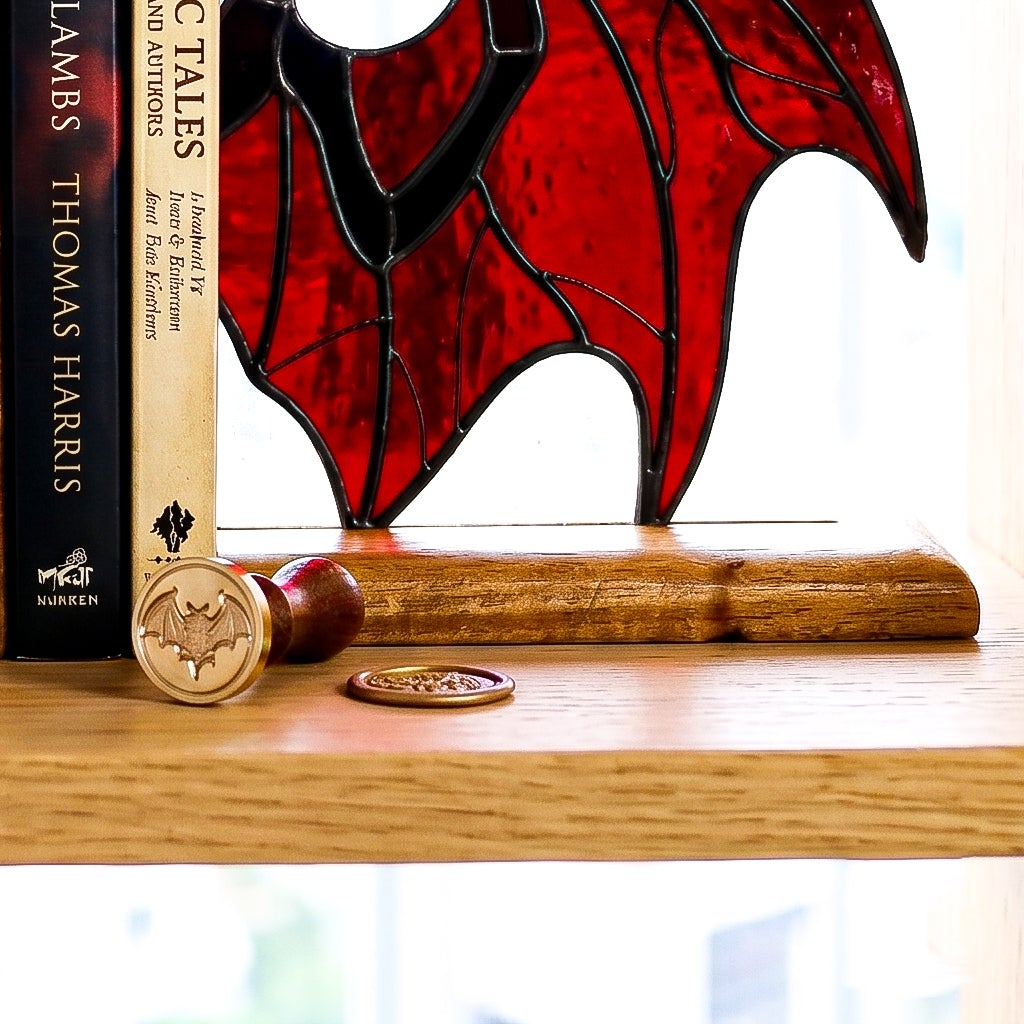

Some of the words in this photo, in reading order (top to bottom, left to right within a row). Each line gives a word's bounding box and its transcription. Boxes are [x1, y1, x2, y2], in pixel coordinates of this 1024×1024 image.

[51, 1, 80, 130] LAMBS
[174, 38, 204, 158] TALES
[53, 173, 80, 336] THOMAS
[54, 355, 80, 492] HARRIS
